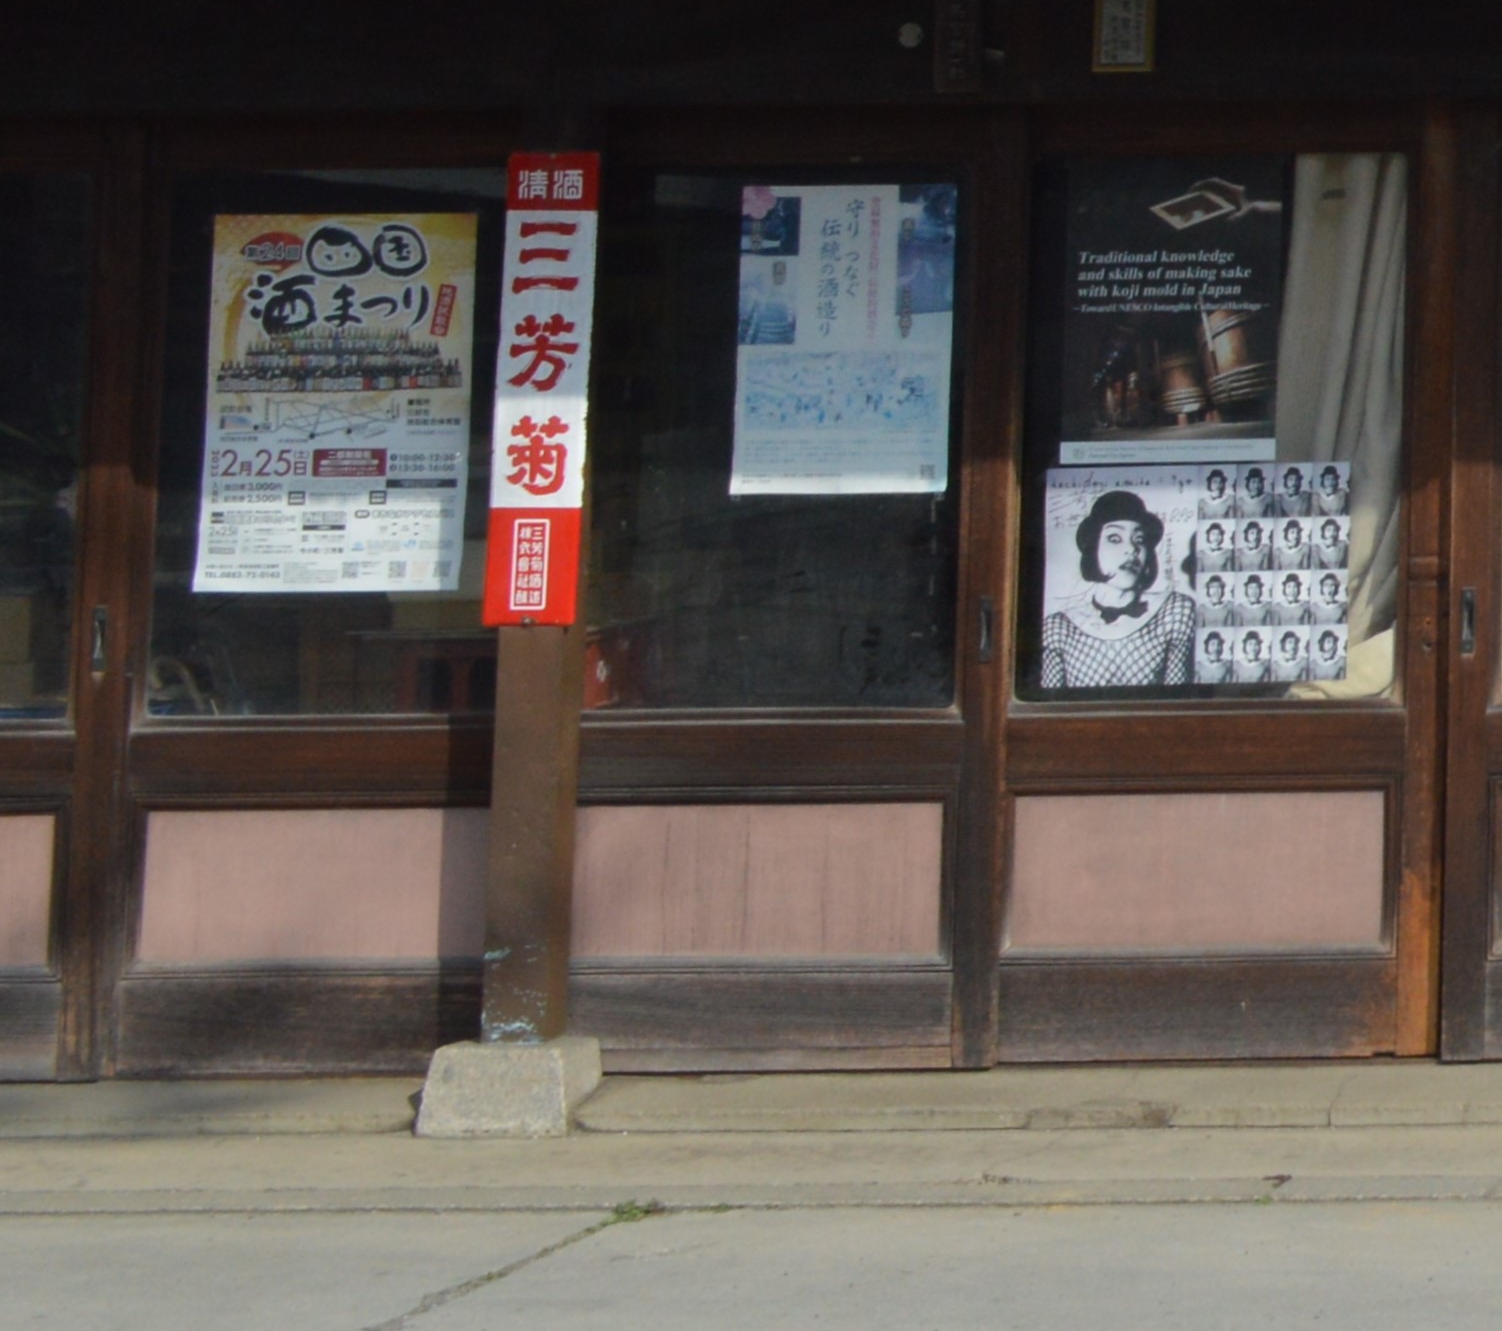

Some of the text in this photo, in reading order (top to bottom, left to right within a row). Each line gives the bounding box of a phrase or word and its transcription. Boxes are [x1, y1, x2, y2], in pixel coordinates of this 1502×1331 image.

[518, 169, 584, 200] 清酒
[843, 198, 865, 297] 守り つなぐ
[1079, 249, 1235, 265] Traditional knowledge
[817, 219, 842, 337] 伝統の酒造り
[1077, 266, 1252, 281] and skills of making sake
[1078, 283, 1242, 300] with koji mold in Japan
[248, 274, 429, 336] 酒まつり
[506, 221, 580, 496] 三芳菊
